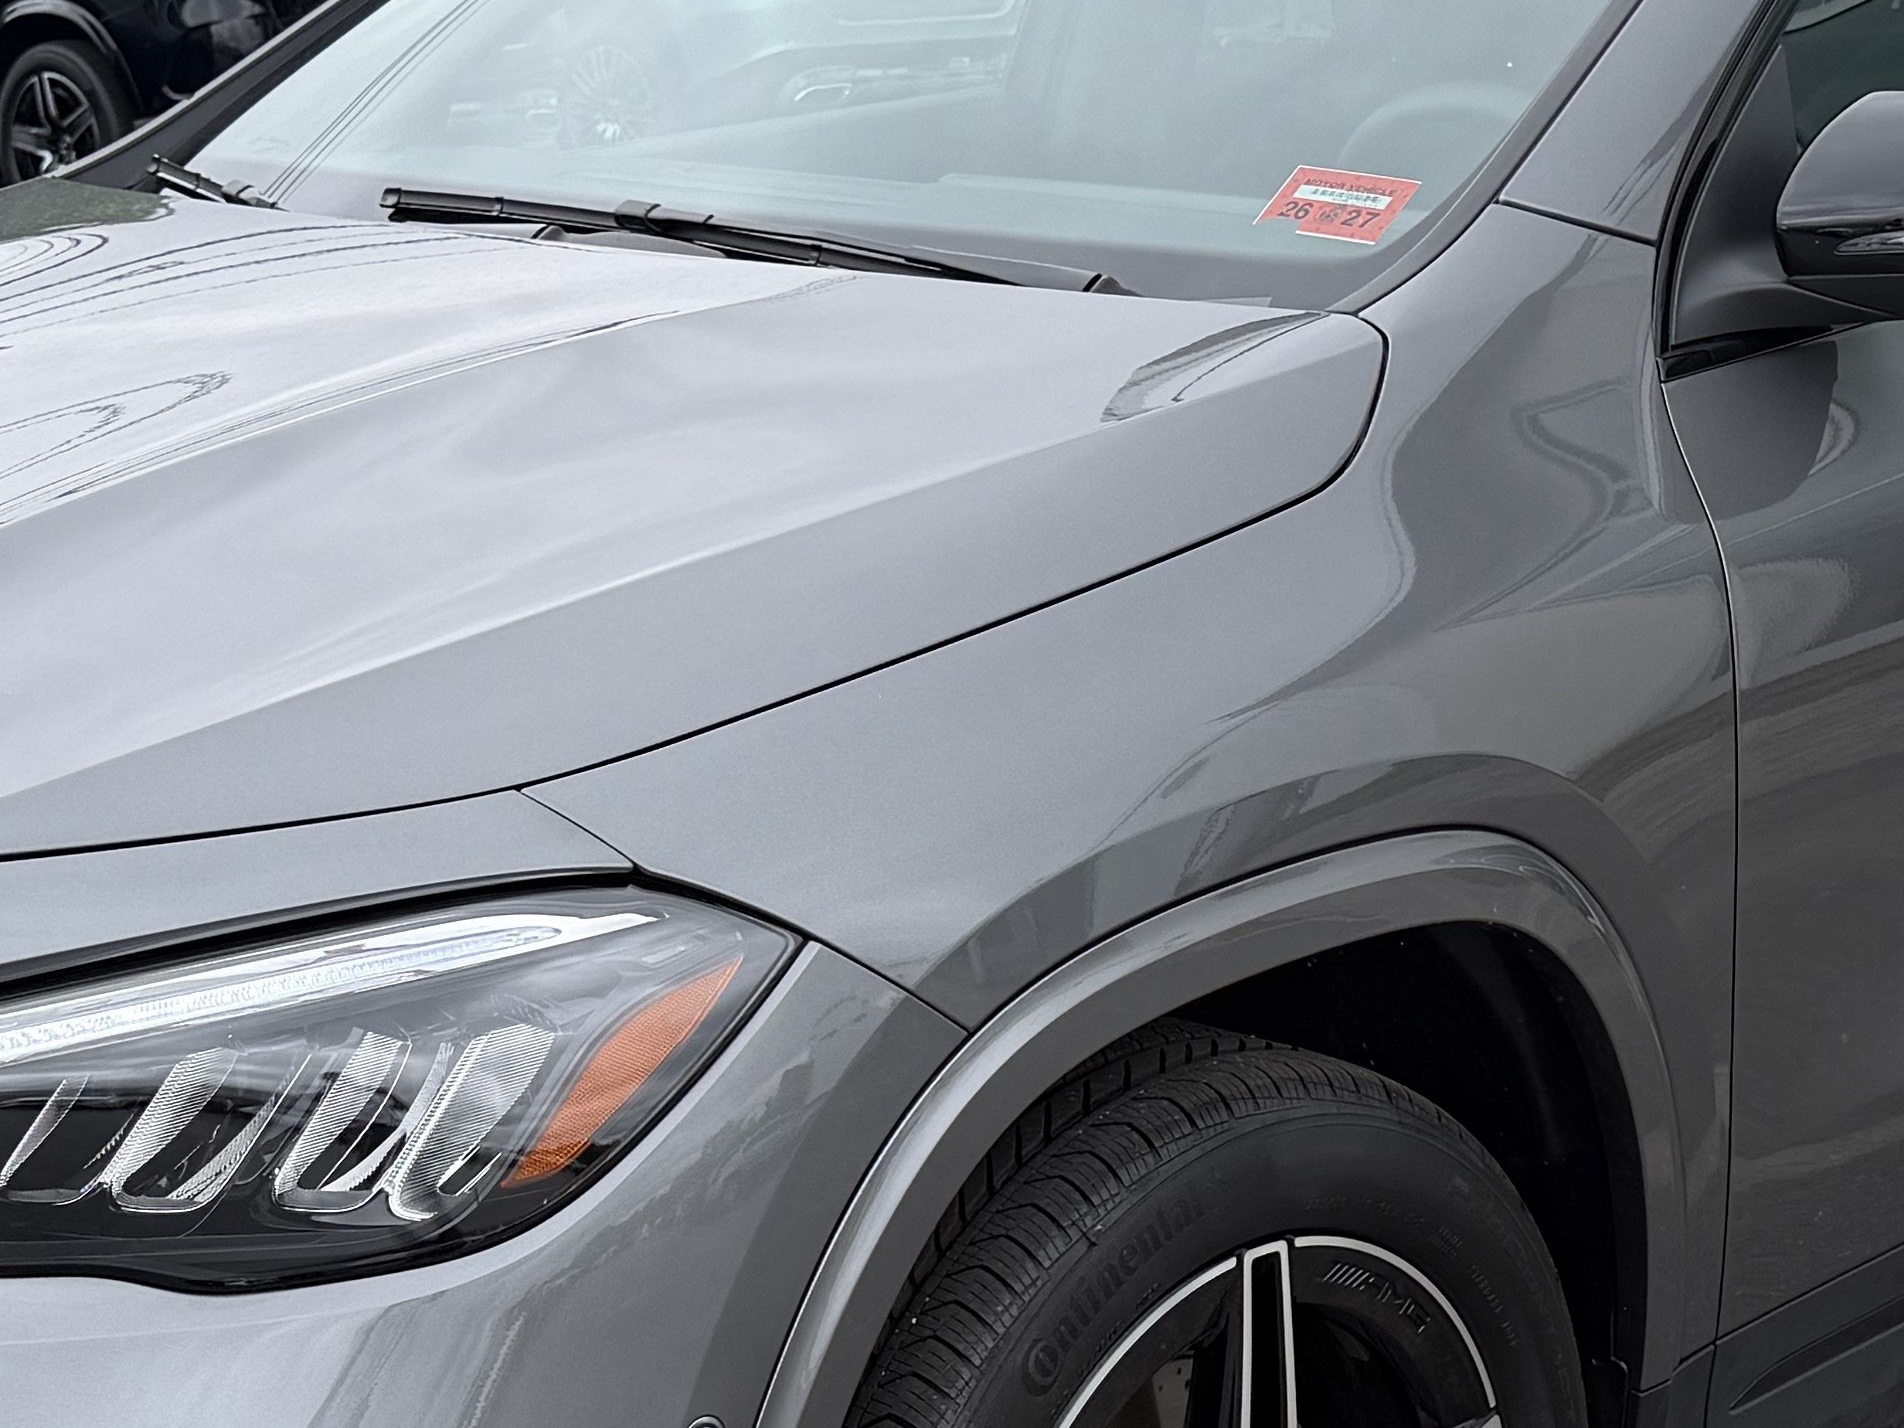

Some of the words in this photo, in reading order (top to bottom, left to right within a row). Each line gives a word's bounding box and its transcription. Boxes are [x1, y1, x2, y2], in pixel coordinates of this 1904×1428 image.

[1277, 200, 1314, 221] 26
[1340, 209, 1381, 229] 27
[1021, 1199, 1208, 1398] Continental
